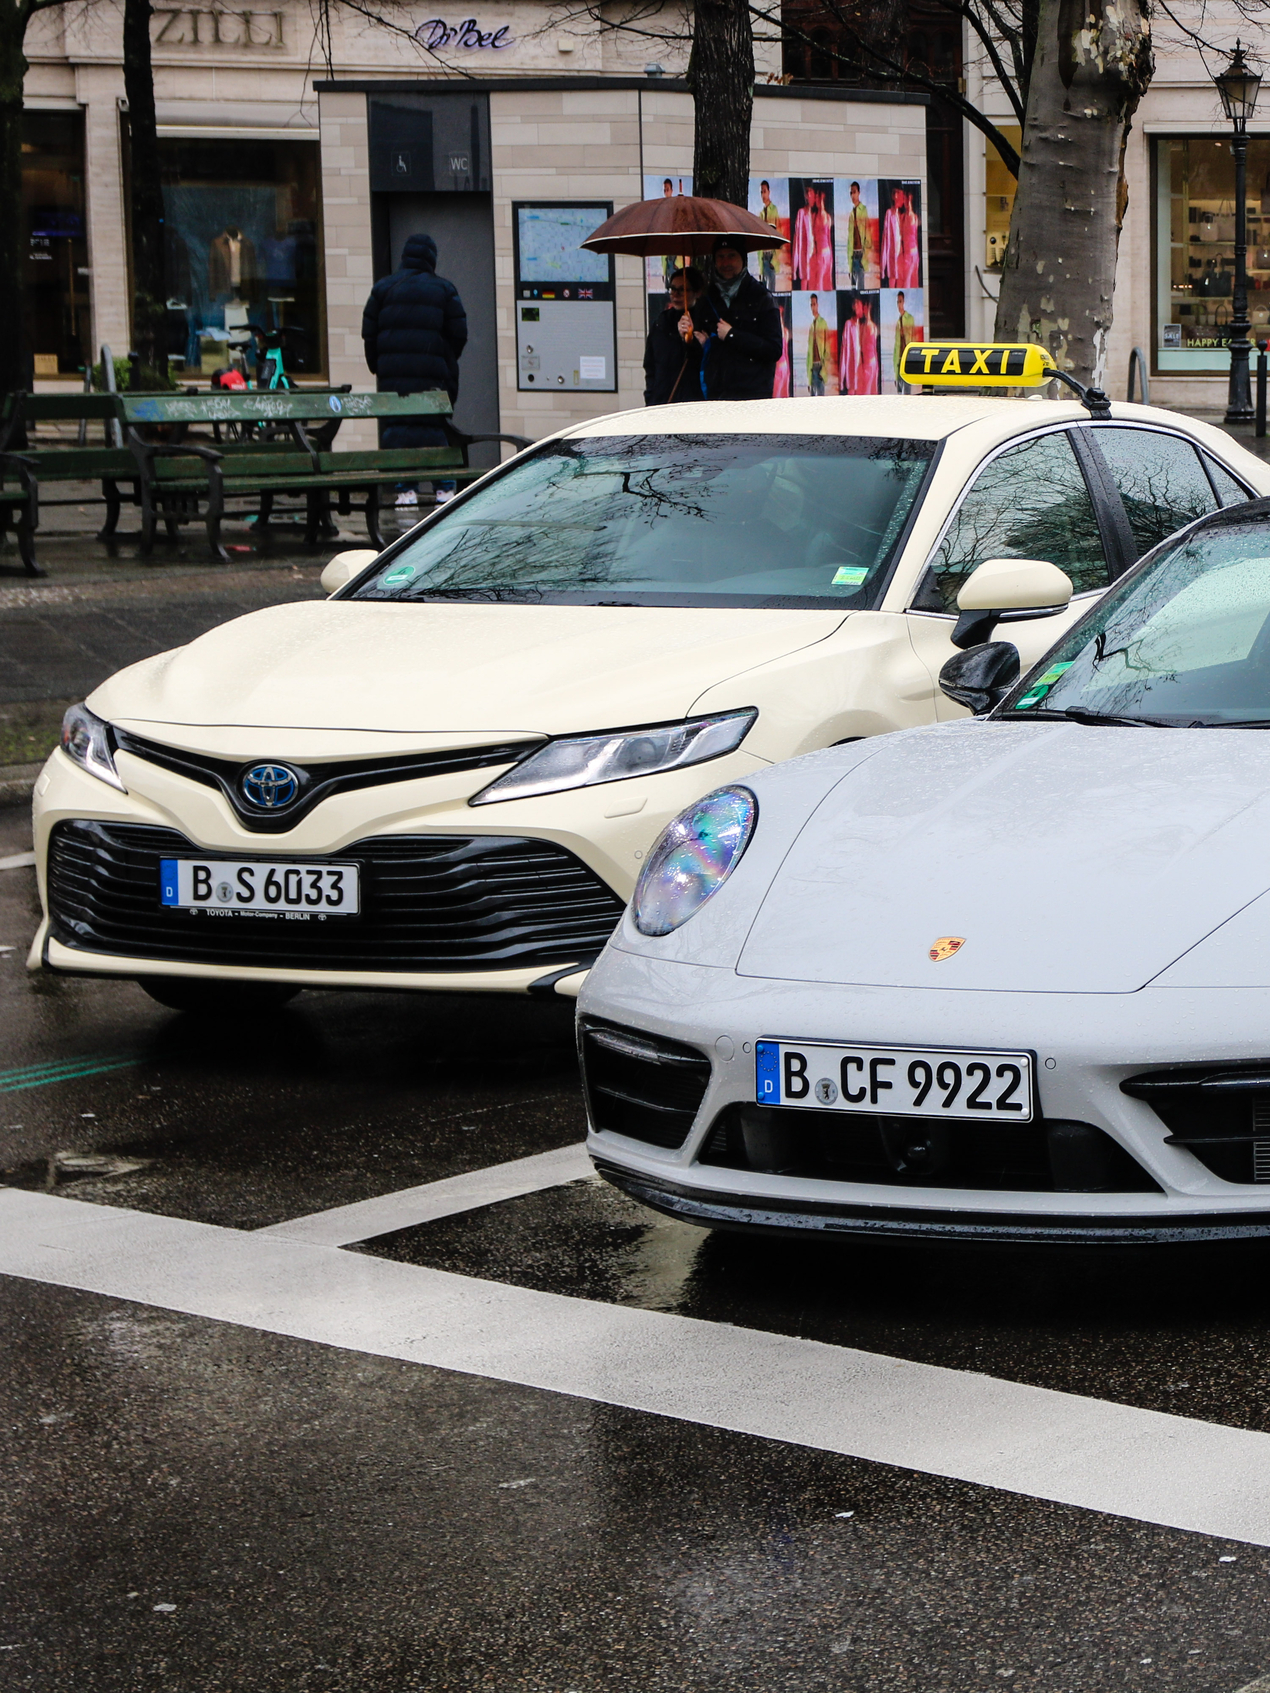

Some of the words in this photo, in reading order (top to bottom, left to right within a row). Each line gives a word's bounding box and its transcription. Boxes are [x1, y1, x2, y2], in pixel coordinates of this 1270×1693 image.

[153, 9, 285, 47] ZILLI
[450, 158, 468, 170] WC
[1187, 338, 1219, 347] HAPPY
[920, 349, 1010, 374] TAXI
[166, 887, 173, 897] D
[193, 865, 212, 901] B
[236, 867, 255, 903] S
[264, 868, 344, 906] 6033
[206, 908, 233, 917] TOYOTA
[285, 912, 310, 921] BERLIN
[764, 1080, 773, 1092] D
[783, 1051, 810, 1099] B
[840, 1056, 896, 1104] CF
[907, 1059, 1023, 1111] 9922
